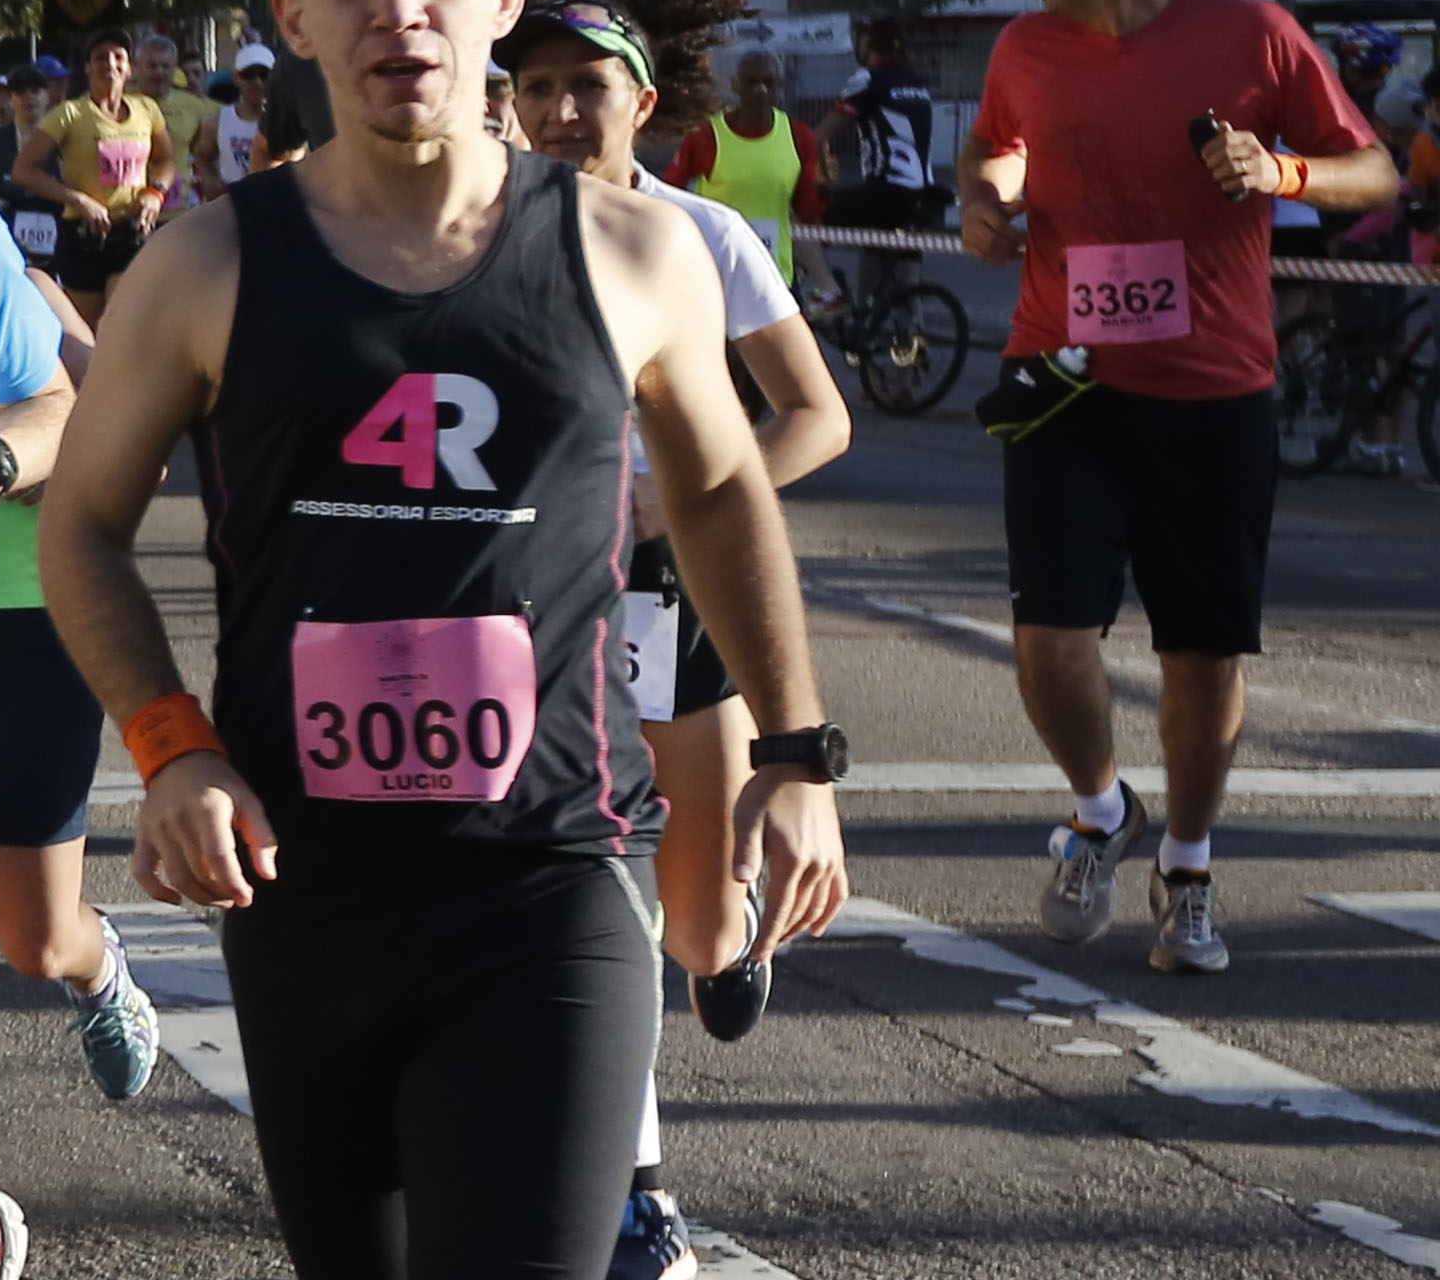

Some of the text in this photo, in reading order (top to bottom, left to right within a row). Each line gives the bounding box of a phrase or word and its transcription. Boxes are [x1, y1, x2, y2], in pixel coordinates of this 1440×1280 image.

[1073, 277, 1177, 317] 3362
[341, 373, 499, 491] 4R
[292, 500, 424, 521] ASSESSORIA
[306, 698, 511, 771] 3060
[382, 774, 453, 791] LUCIO
